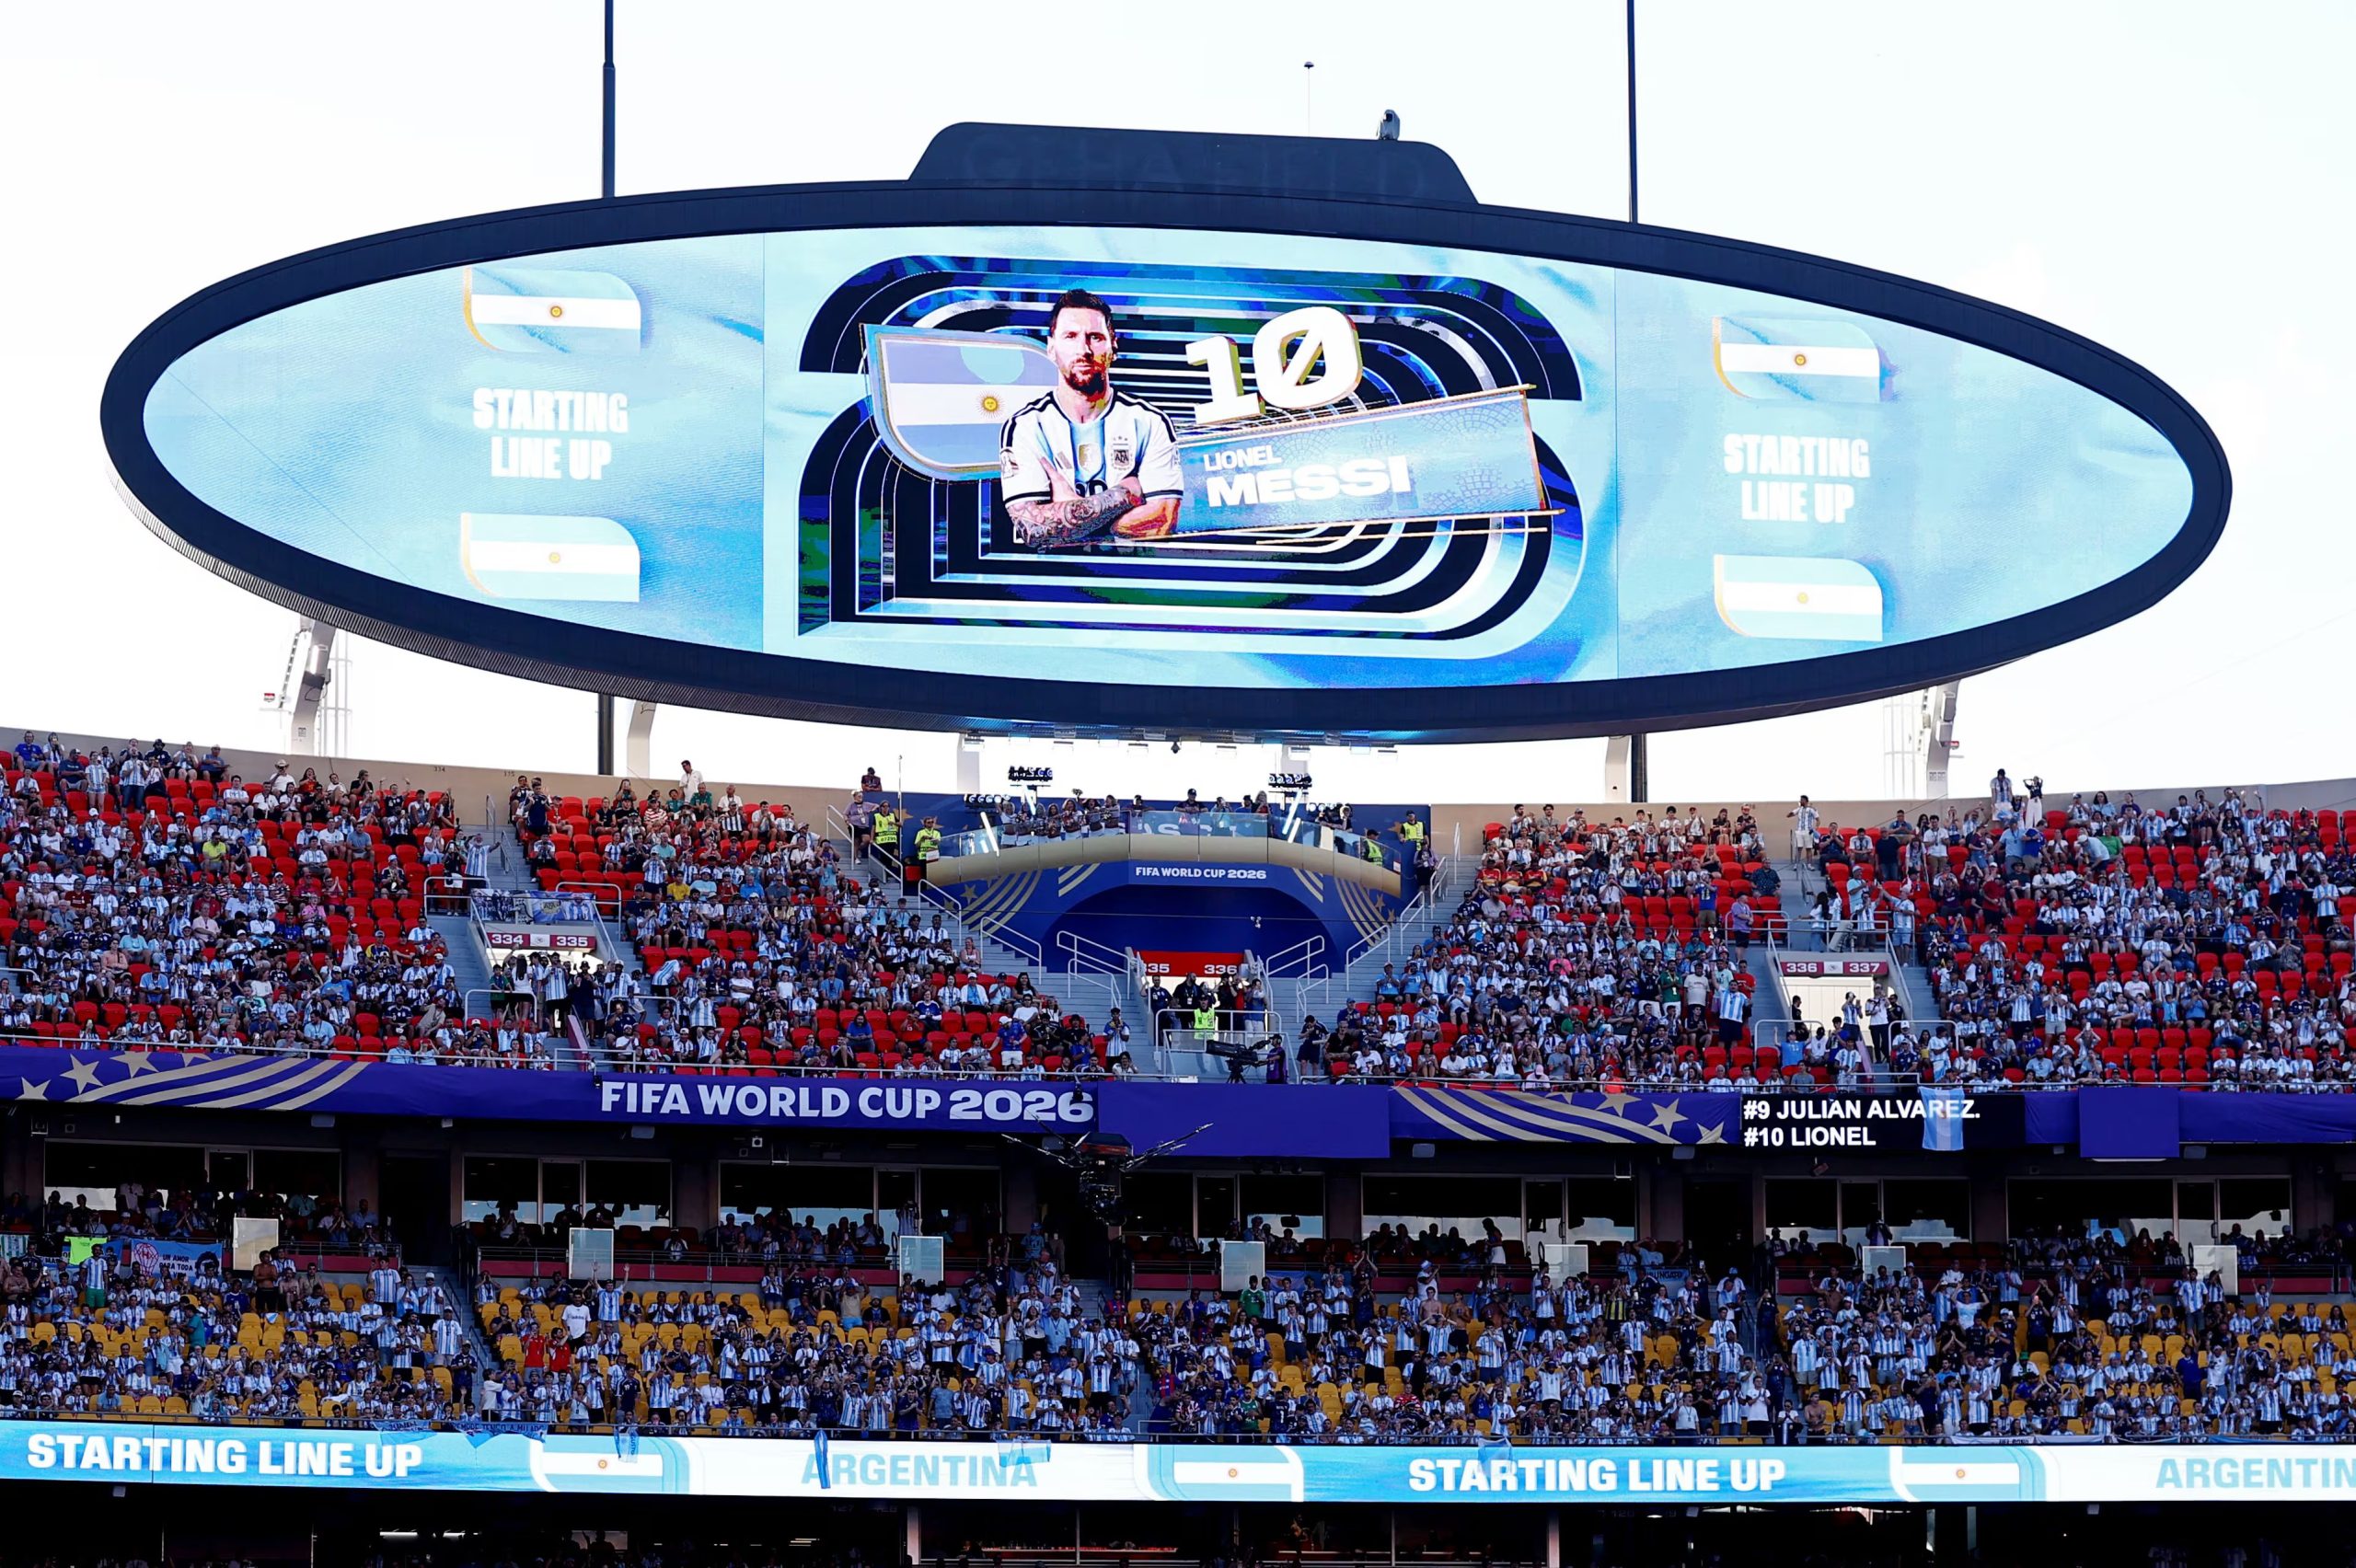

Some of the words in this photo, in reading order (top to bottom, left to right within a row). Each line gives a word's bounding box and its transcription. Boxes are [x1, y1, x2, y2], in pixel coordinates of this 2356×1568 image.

[1184, 306, 1363, 426] 10
[472, 387, 629, 432] STARTING
[491, 436, 562, 479] LINE
[569, 438, 612, 480] UP
[1203, 444, 1282, 471] LIONEL
[1723, 433, 1870, 478] STARTING
[1206, 455, 1412, 508] MESSI
[1741, 479, 1807, 522] LINE
[1814, 481, 1854, 524] UP
[1135, 867, 1160, 877] FIFA
[1161, 868, 1202, 878] WORLD
[1203, 869, 1226, 878] CUP
[1227, 870, 1267, 880] 2026
[491, 934, 524, 945] 334
[556, 936, 588, 946] 335
[1204, 964, 1238, 974] 336
[1786, 963, 1818, 973] 336
[1849, 963, 1880, 973] 337
[600, 1081, 690, 1114] FIFA
[697, 1084, 850, 1117] WORLD
[858, 1087, 941, 1119] CUP
[949, 1090, 1093, 1123] 2026
[1743, 1100, 1771, 1120] #9
[1776, 1100, 1862, 1120] JULIAN
[1866, 1100, 1981, 1120] ALVAREZ.
[1743, 1127, 1784, 1147] #10
[1791, 1127, 1877, 1147] LIONEL
[28, 1434, 246, 1474] STARTING
[260, 1442, 352, 1476] LINE
[365, 1445, 422, 1478] UP
[802, 1453, 1038, 1488] ARGENTINA
[1409, 1458, 1617, 1492] STARTING
[1629, 1459, 1719, 1492] LINE
[1731, 1459, 1785, 1491] UP
[2155, 1458, 2356, 1489] ARGENTIN
